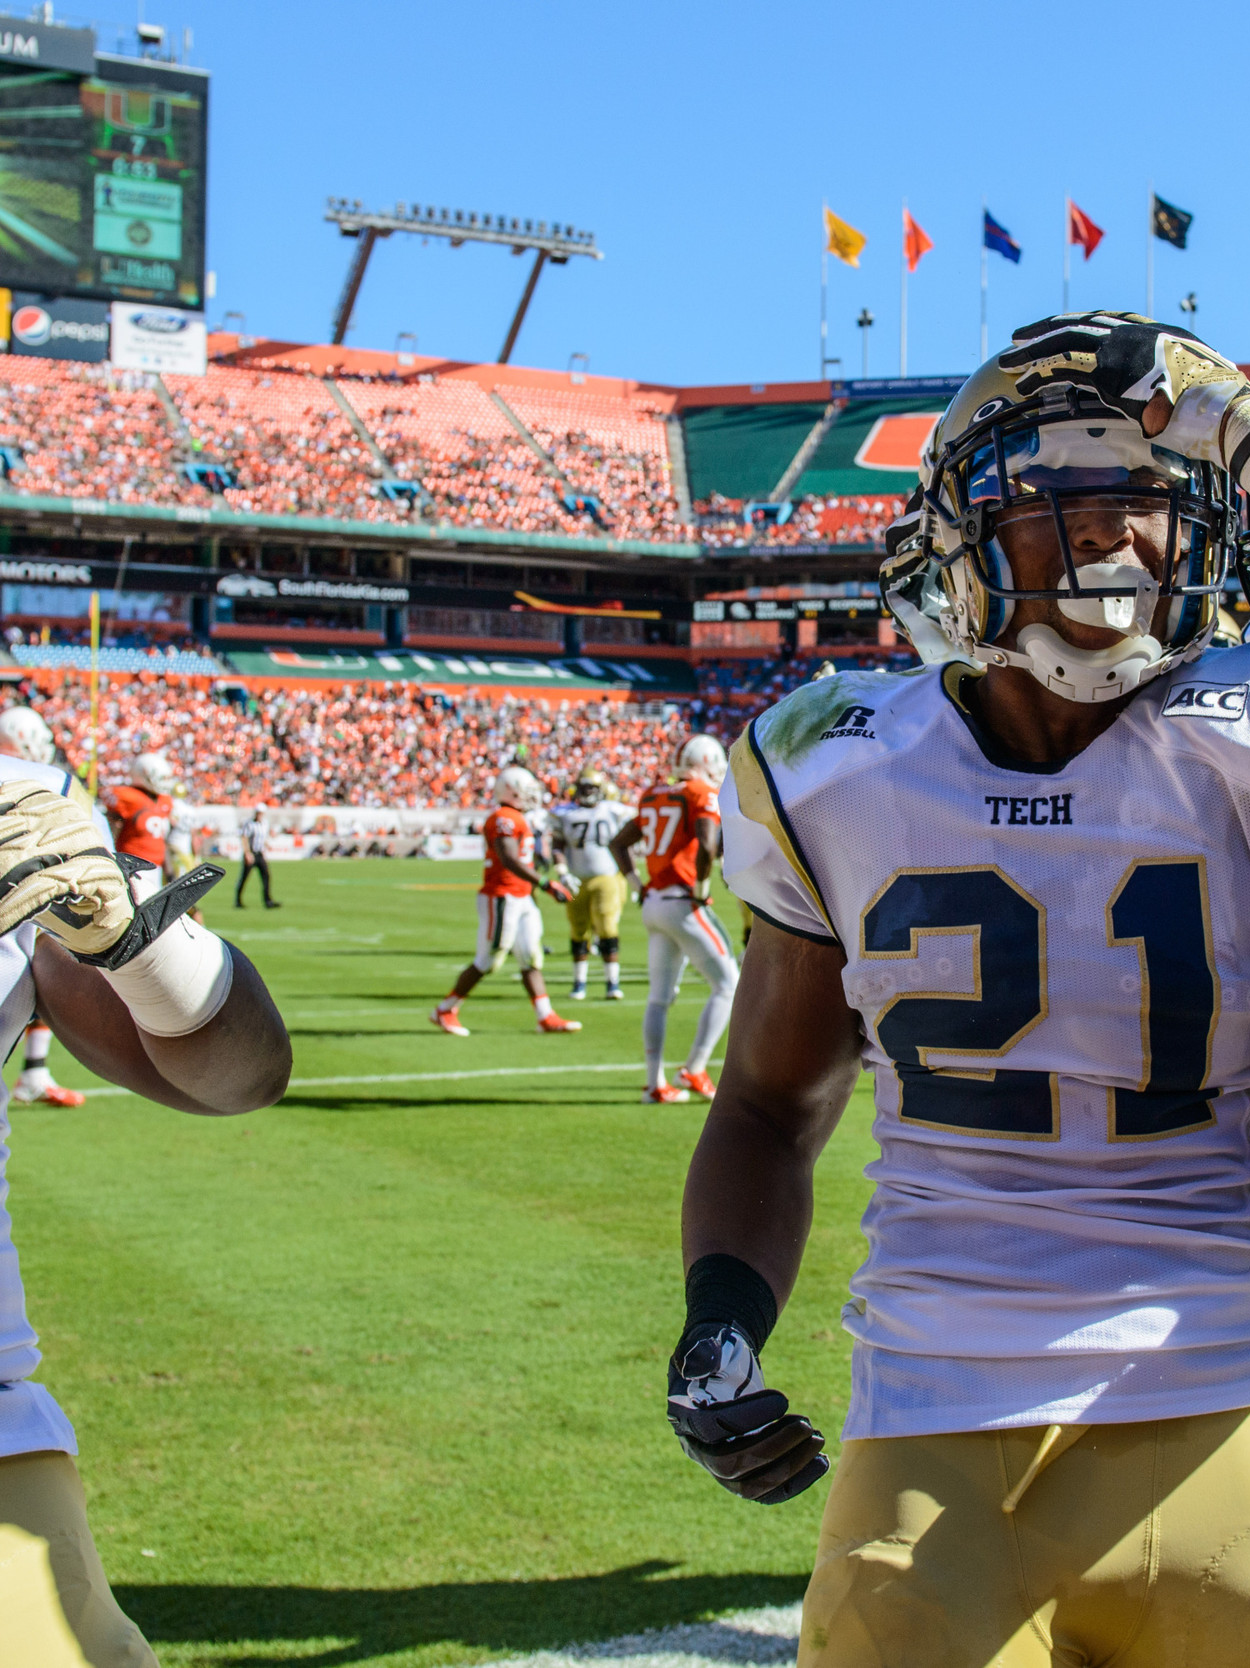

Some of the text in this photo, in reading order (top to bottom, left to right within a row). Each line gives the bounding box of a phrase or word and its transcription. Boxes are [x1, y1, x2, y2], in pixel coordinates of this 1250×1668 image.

[51, 320, 109, 343] pepsi
[1167, 687, 1246, 712] ACC
[819, 727, 876, 741] RUSSELL
[985, 793, 1073, 825] TECH
[572, 821, 610, 848] 70
[641, 806, 682, 856] 37
[860, 854, 1221, 1144] 21
